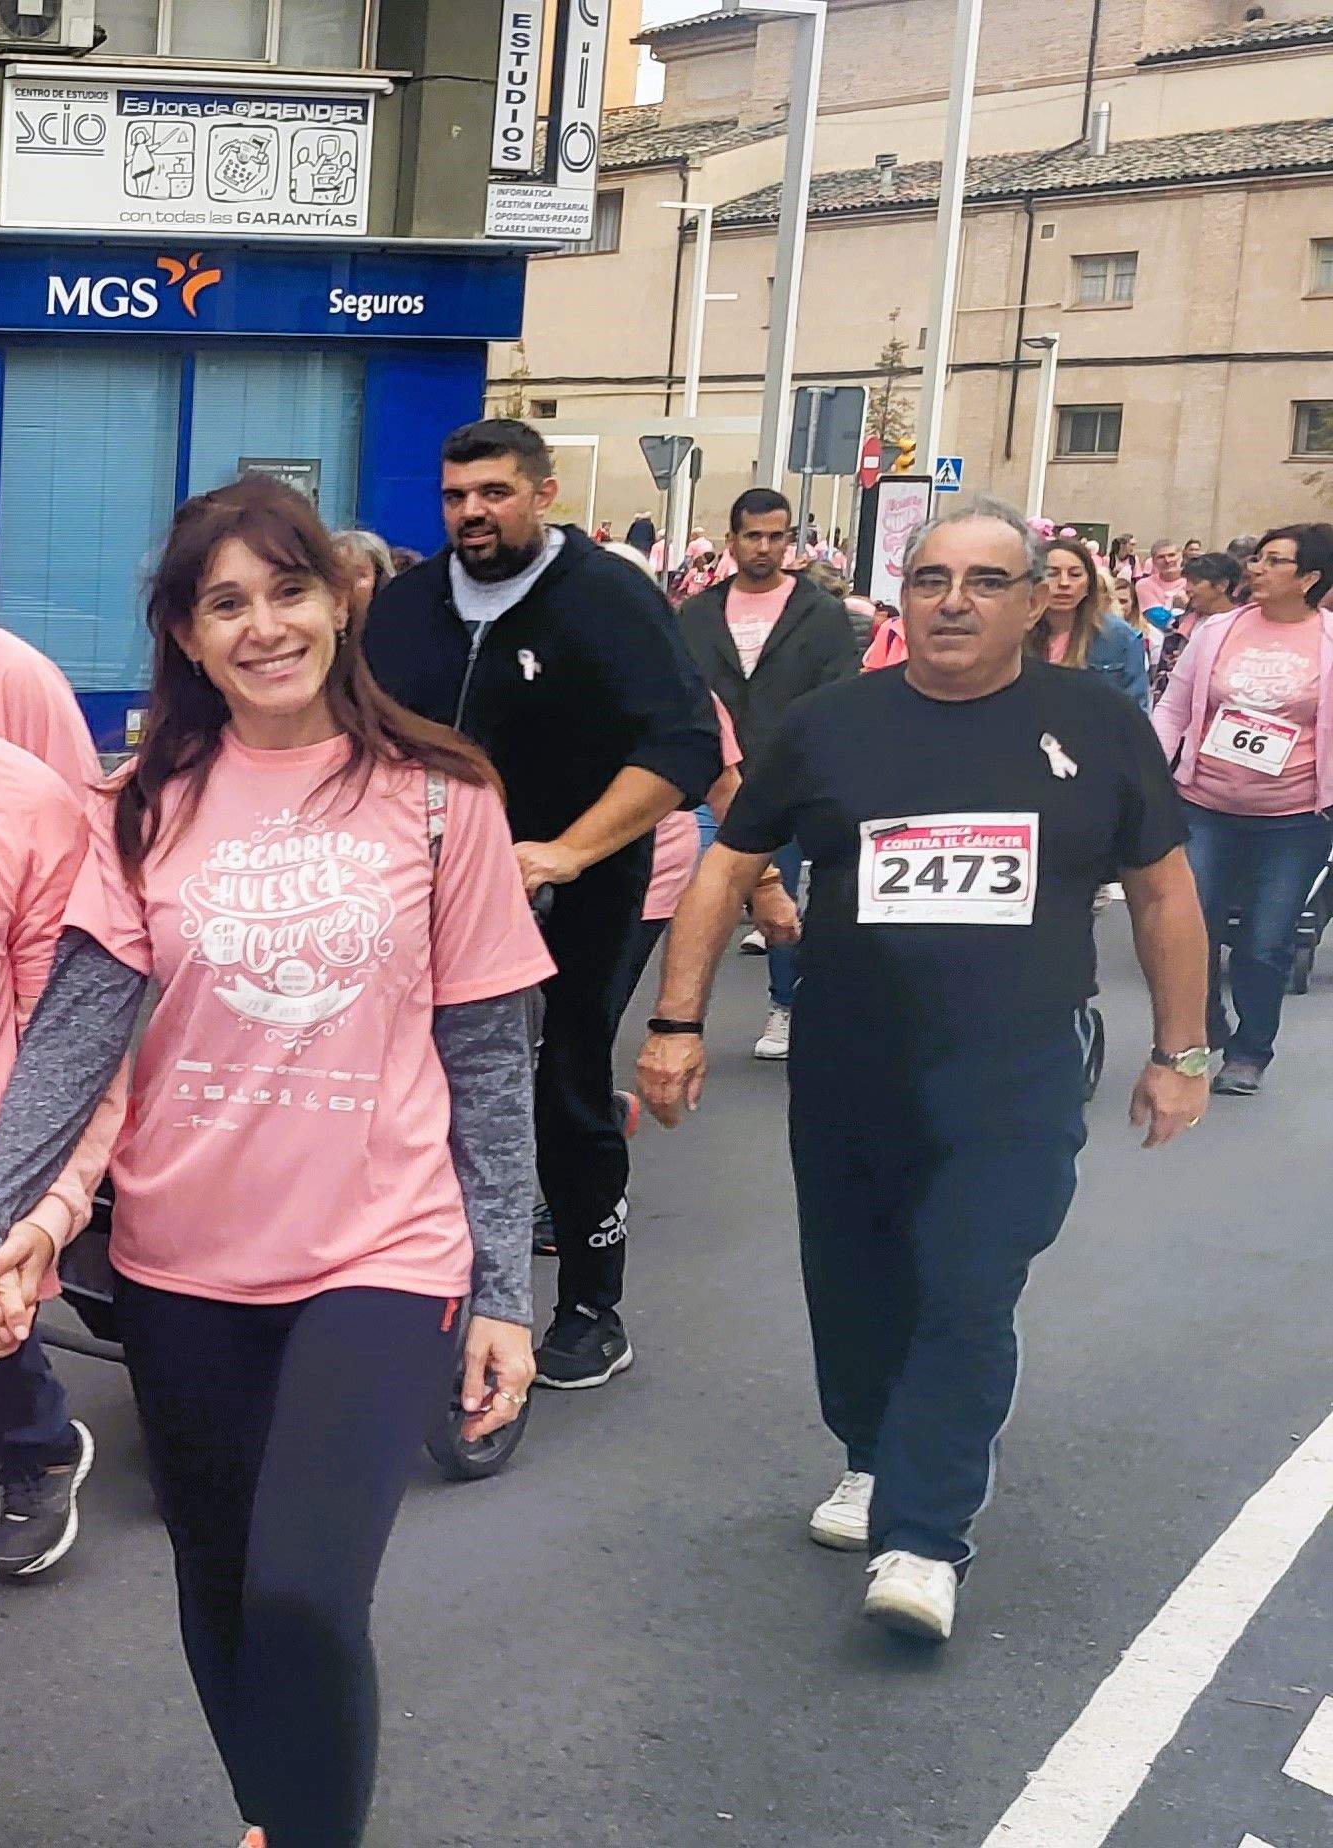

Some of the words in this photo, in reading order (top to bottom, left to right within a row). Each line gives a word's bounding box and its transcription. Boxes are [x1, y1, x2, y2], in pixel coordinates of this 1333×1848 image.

[14, 88, 50, 97] CENTRO
[52, 89, 64, 98] DE
[66, 90, 108, 100] ESTUDIOS
[501, 13, 532, 161] ESTUDIOS
[122, 97, 149, 114] Es
[151, 98, 203, 117] hora
[204, 100, 229, 115] de
[233, 101, 363, 121] @PRENDER
[119, 211, 151, 222] con
[155, 210, 206, 223] todas
[209, 210, 233, 224] las
[236, 208, 358, 227] GARANTÍAS
[46, 276, 160, 319] MGS
[328, 287, 425, 322] Seguros
[1233, 729, 1269, 755] 66
[881, 837, 942, 850] CONTRA
[943, 837, 960, 849] EL
[961, 833, 1023, 848] CÁNCER
[217, 860, 341, 911] HUESCA
[879, 854, 1022, 895] 2473
